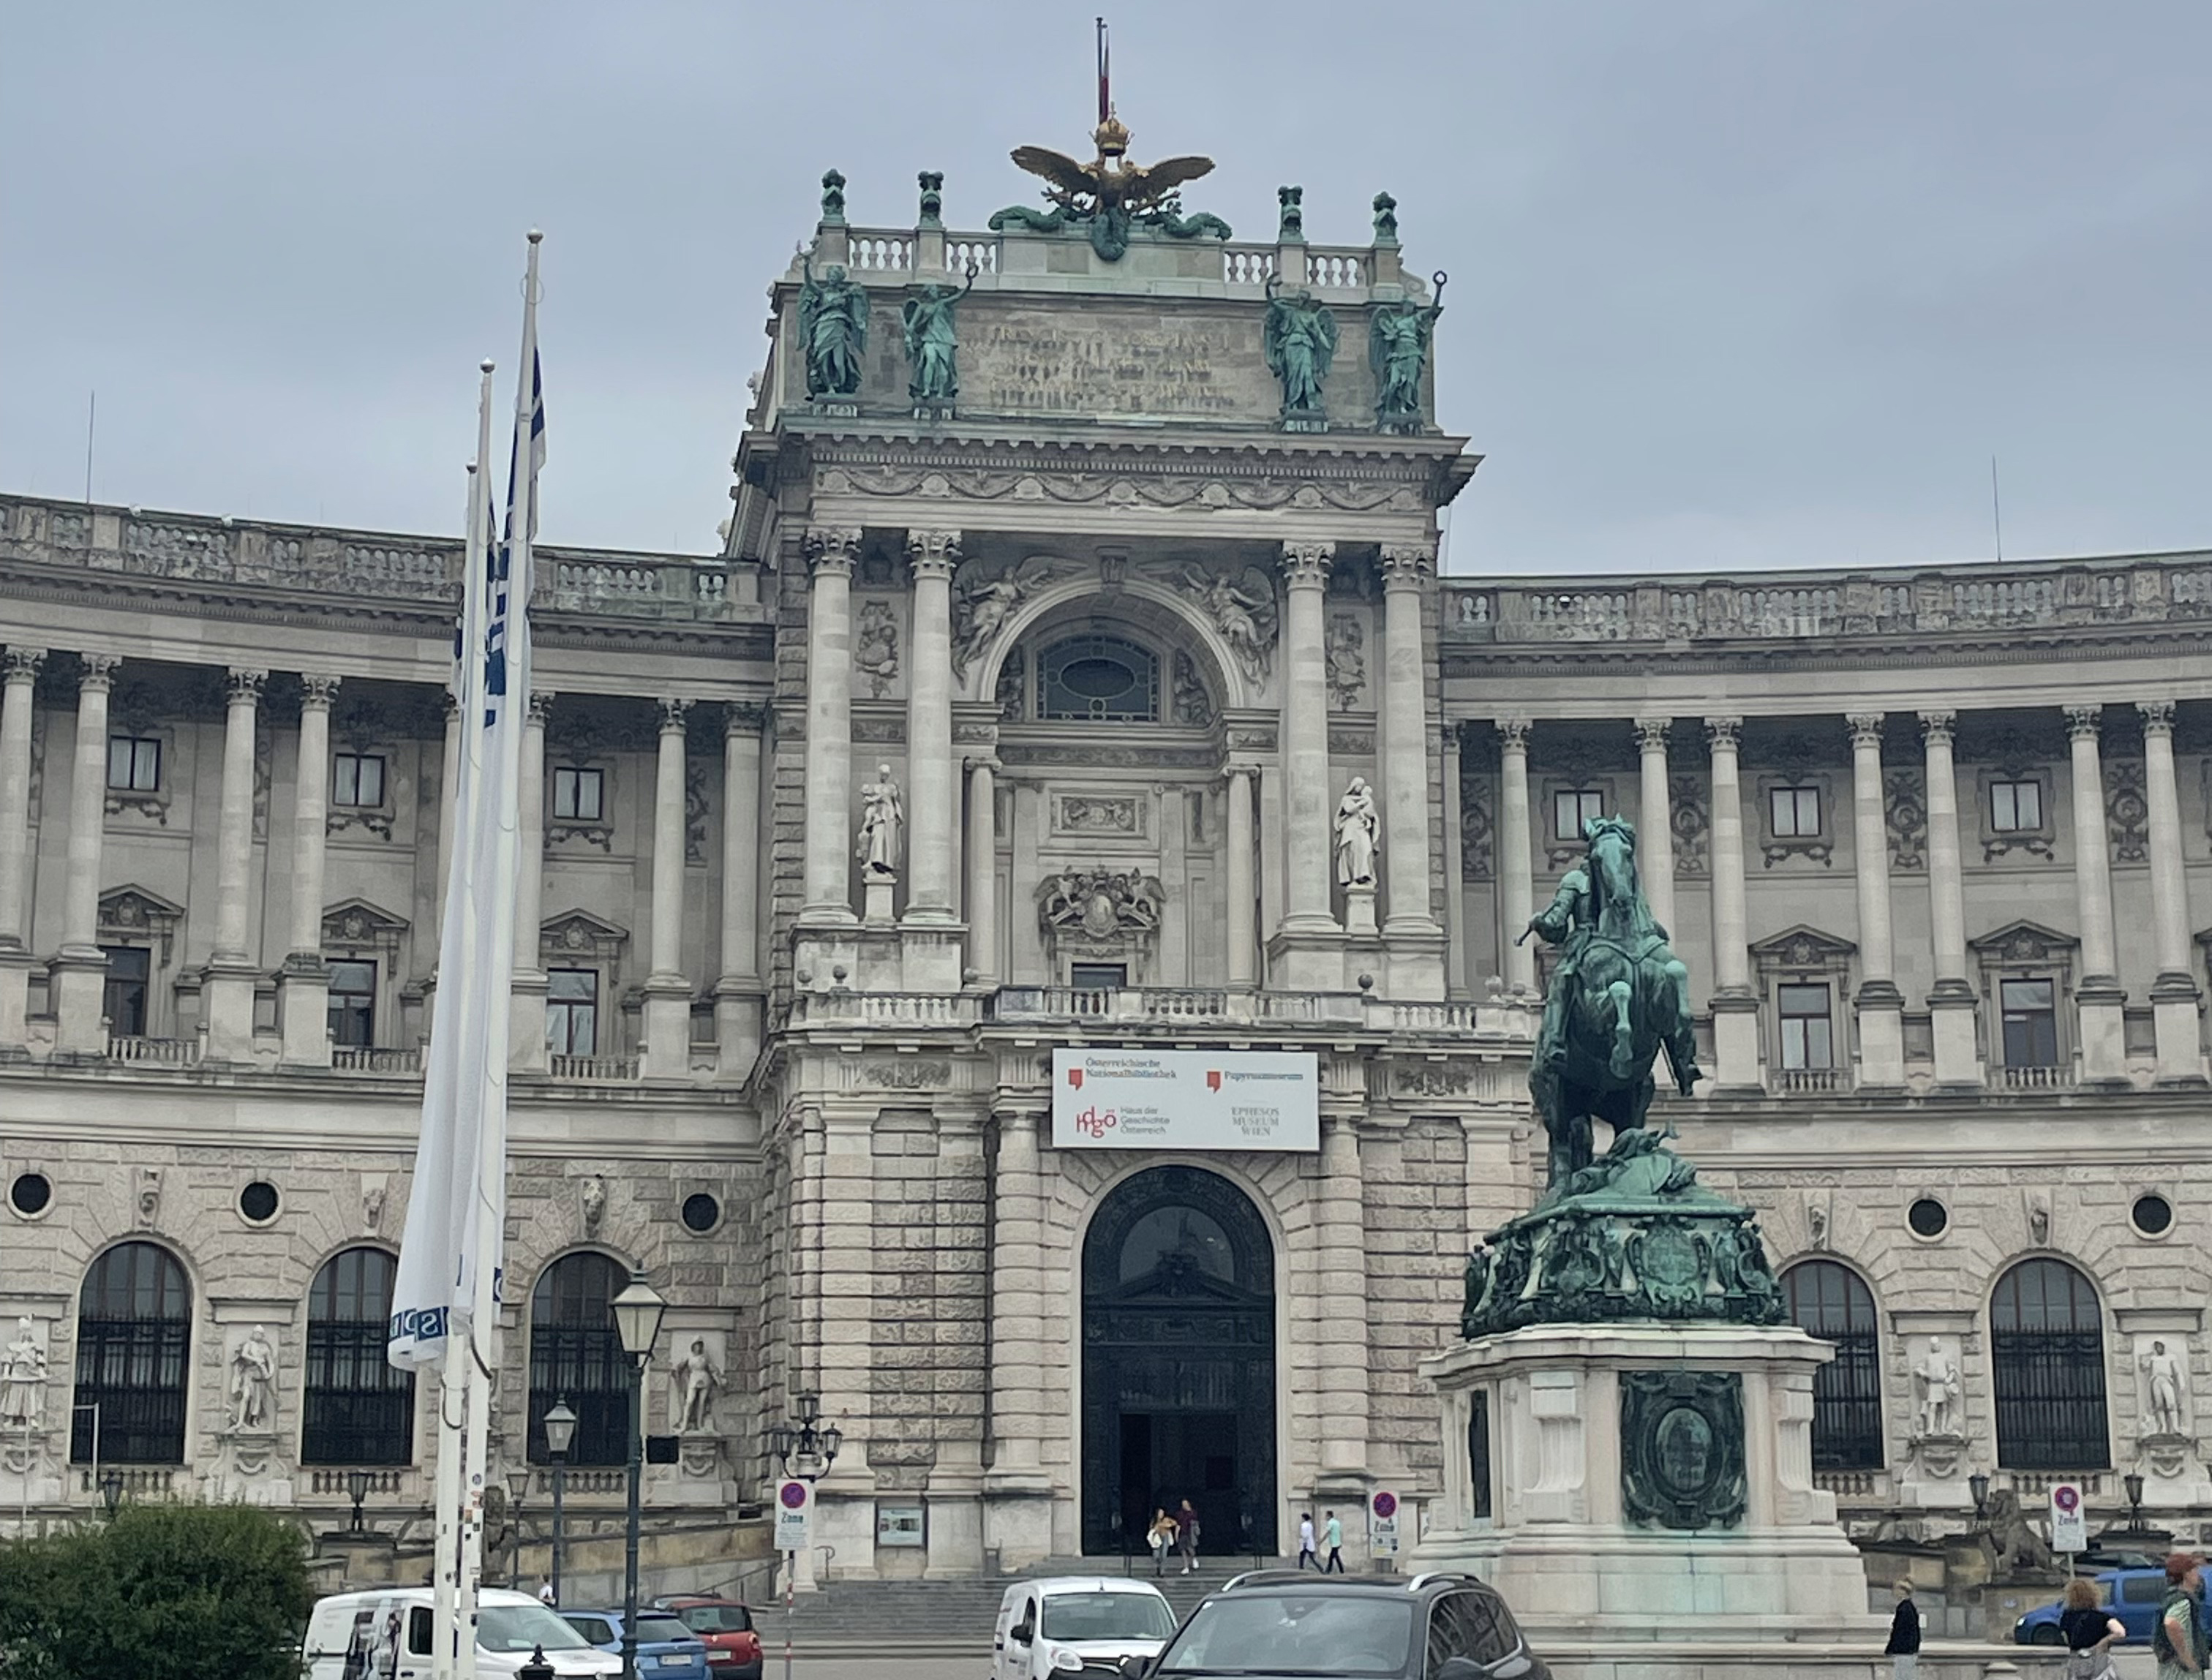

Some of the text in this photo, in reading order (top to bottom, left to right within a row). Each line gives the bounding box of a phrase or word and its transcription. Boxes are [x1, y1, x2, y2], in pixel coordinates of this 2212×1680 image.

[1120, 1105, 1158, 1115] Haus der
[1230, 1107, 1279, 1116] EPHESOS
[1120, 1116, 1170, 1125] Geschichte
[1232, 1117, 1279, 1126] MUSEUM
[1241, 1126, 1271, 1136] WIEN
